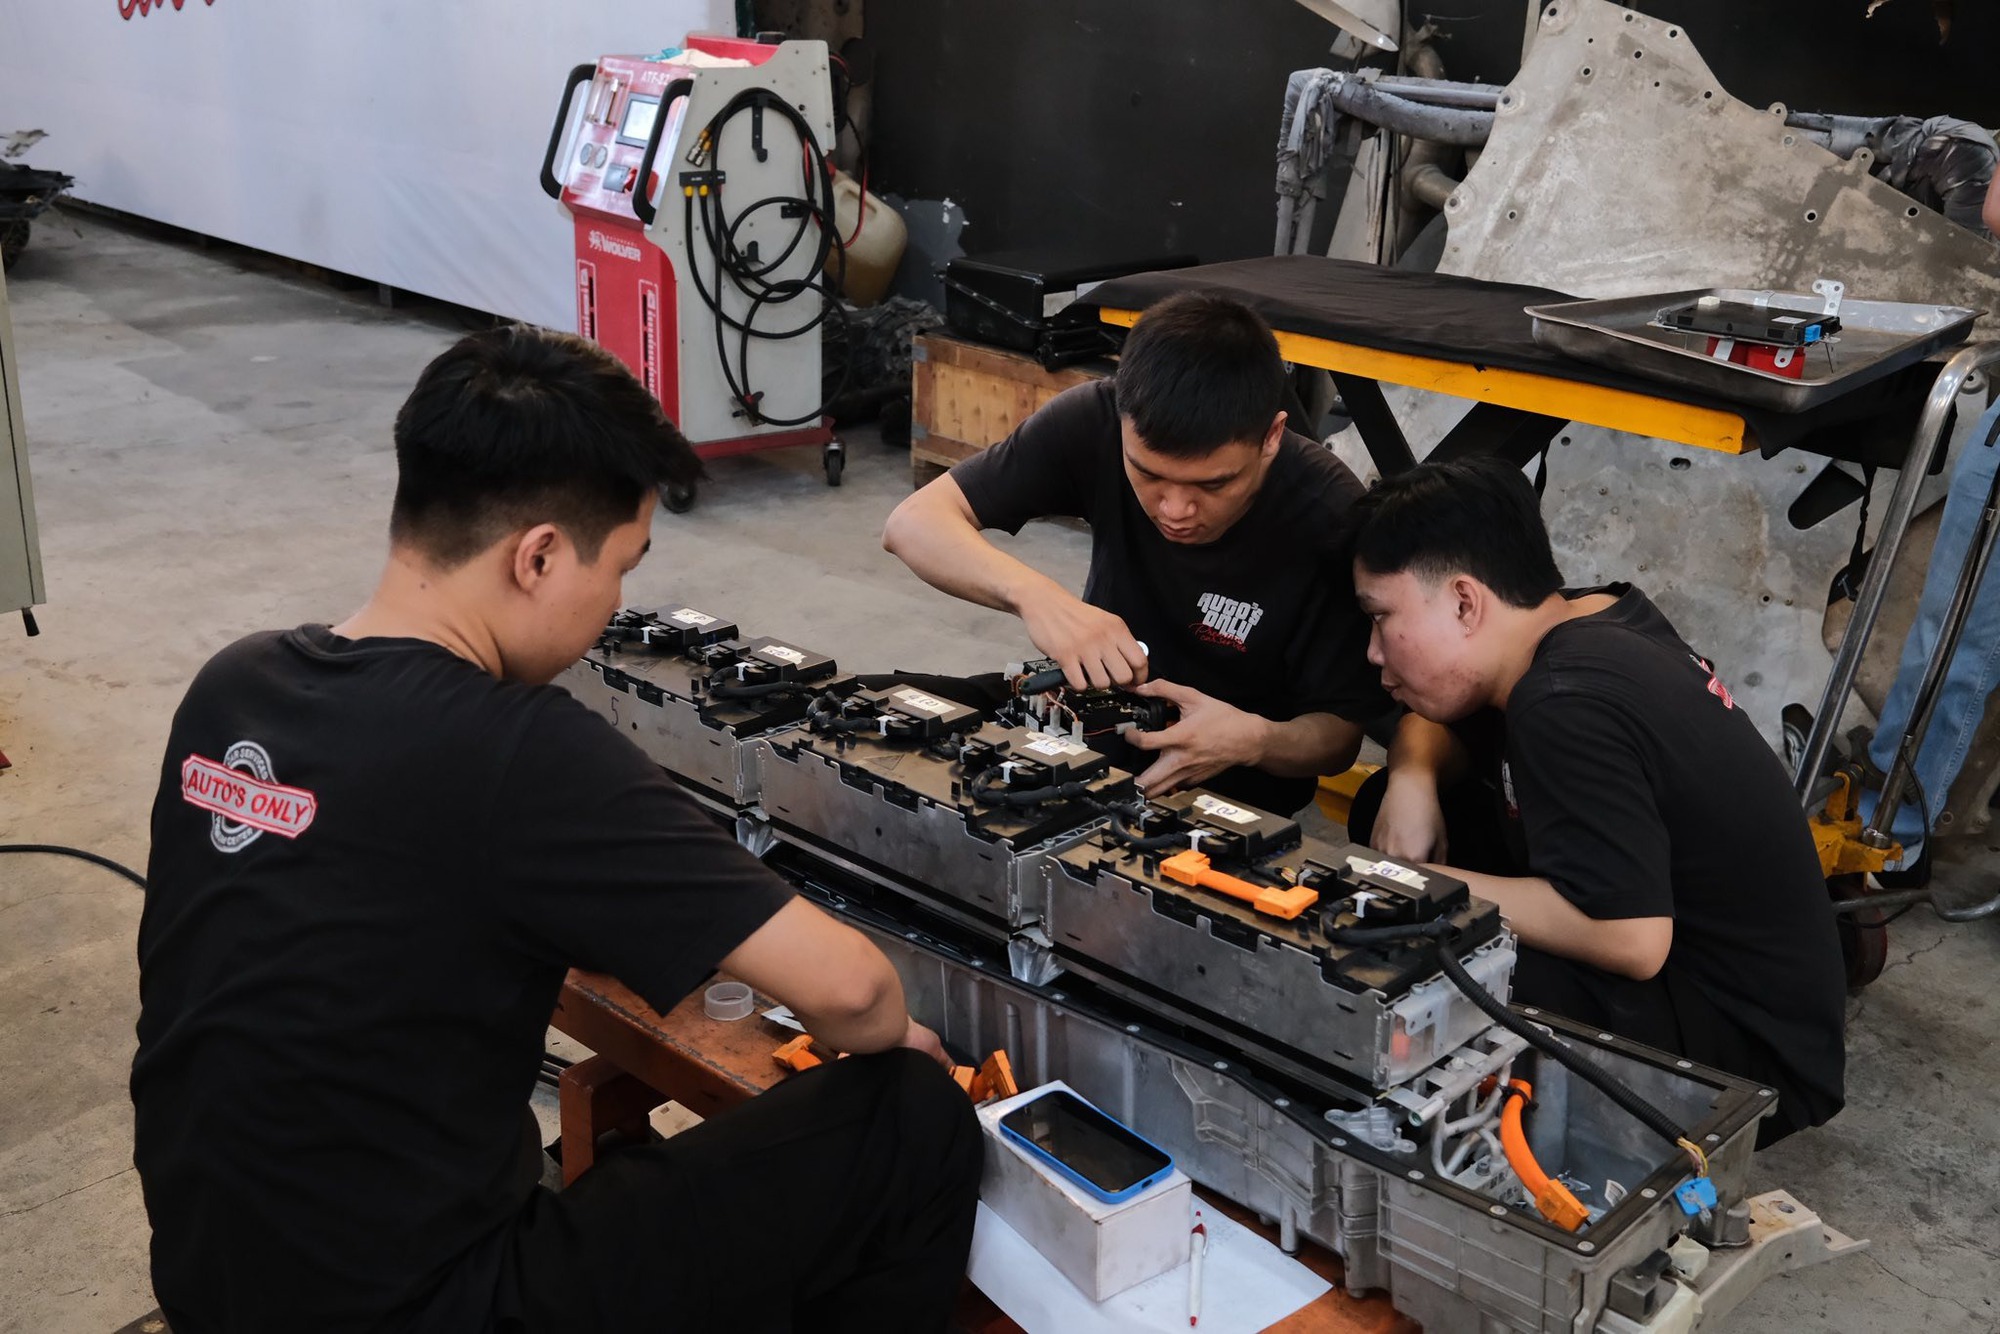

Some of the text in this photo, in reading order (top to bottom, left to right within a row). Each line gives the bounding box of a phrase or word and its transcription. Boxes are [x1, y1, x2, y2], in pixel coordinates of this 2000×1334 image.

[603, 240, 641, 262] WOLVER
[1196, 592, 1264, 626] AUTO'S
[1202, 609, 1253, 644] ONLY
[611, 695, 620, 727] 5
[187, 769, 309, 825] AUTO'S ONLY
